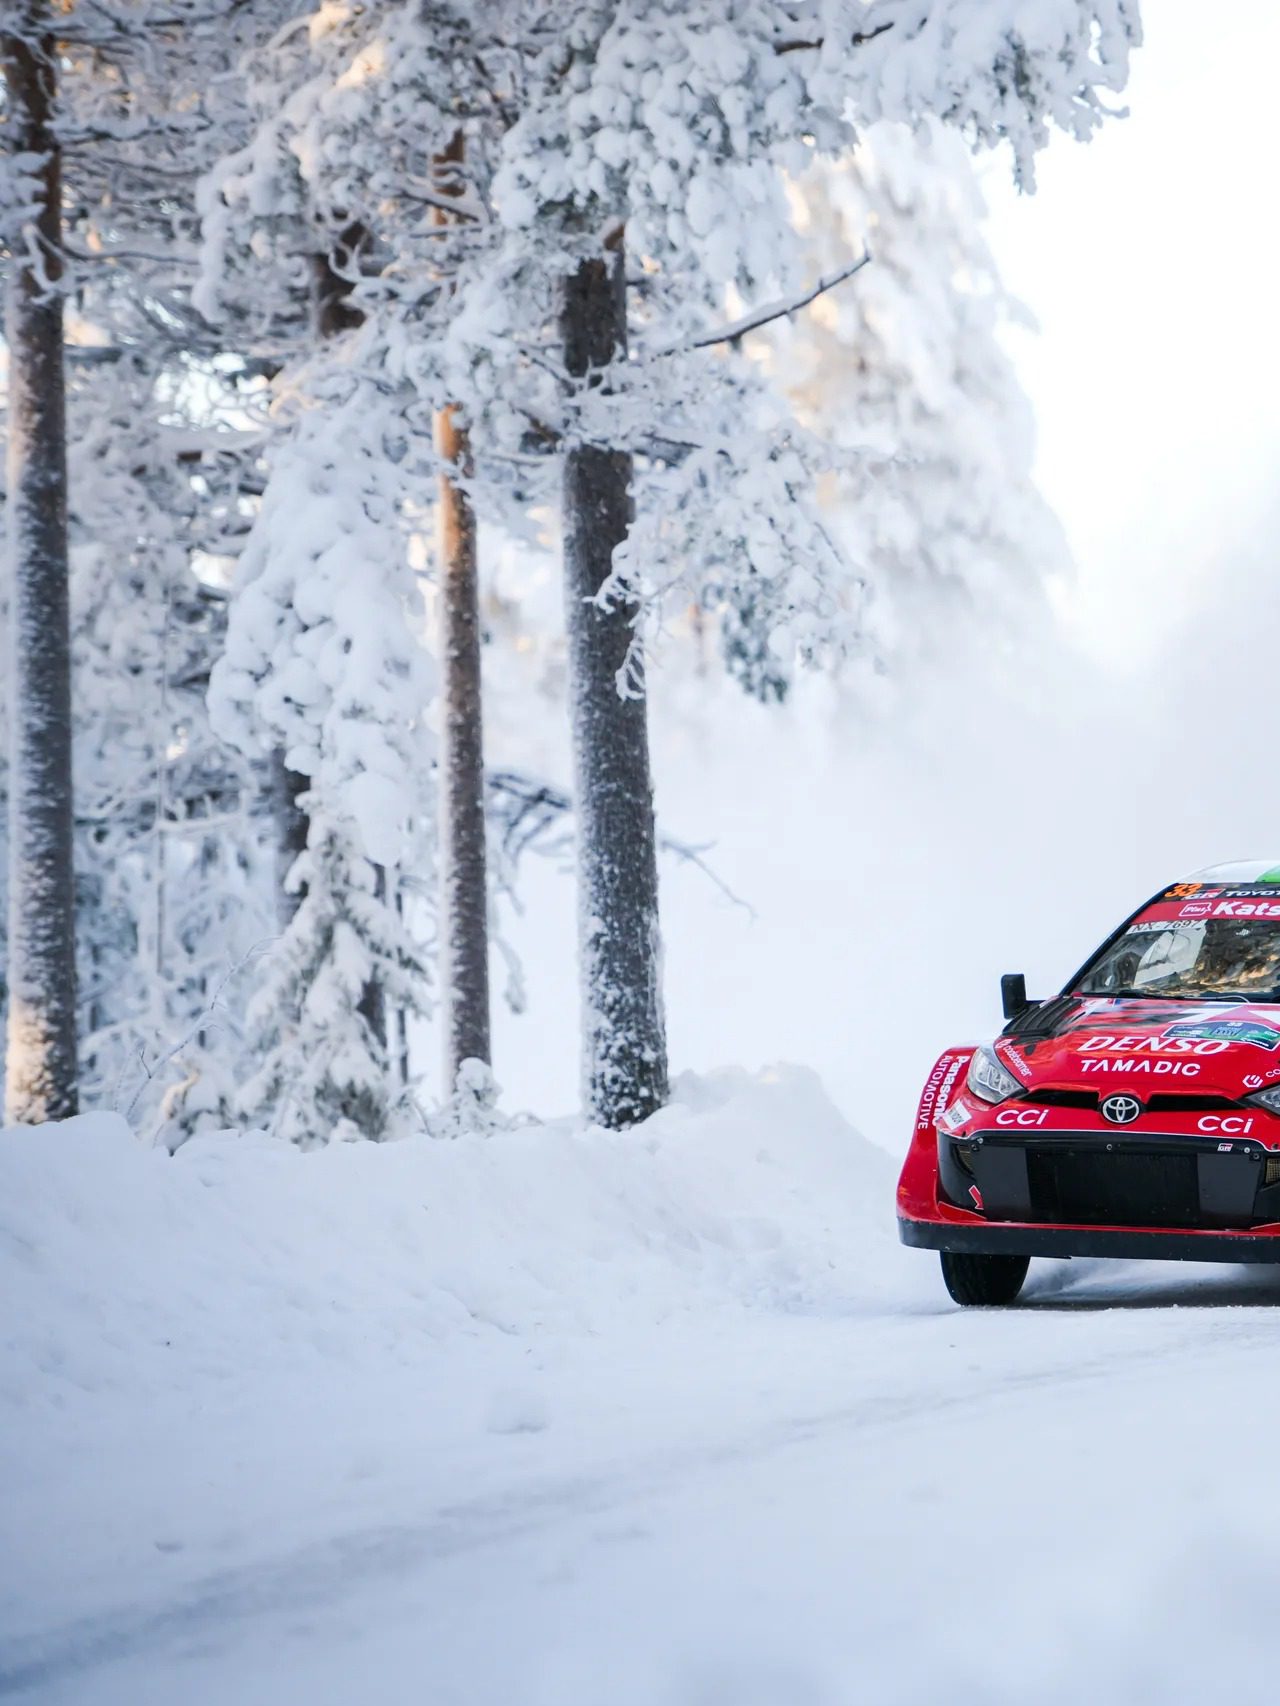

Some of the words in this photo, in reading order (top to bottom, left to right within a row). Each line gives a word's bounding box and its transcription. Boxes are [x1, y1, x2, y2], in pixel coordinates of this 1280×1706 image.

[1164, 883, 1203, 897] 33
[1077, 1036, 1231, 1055] DENSO
[1080, 1059, 1201, 1076] TAMADIC
[917, 1055, 953, 1129] AUTOMOTIVE
